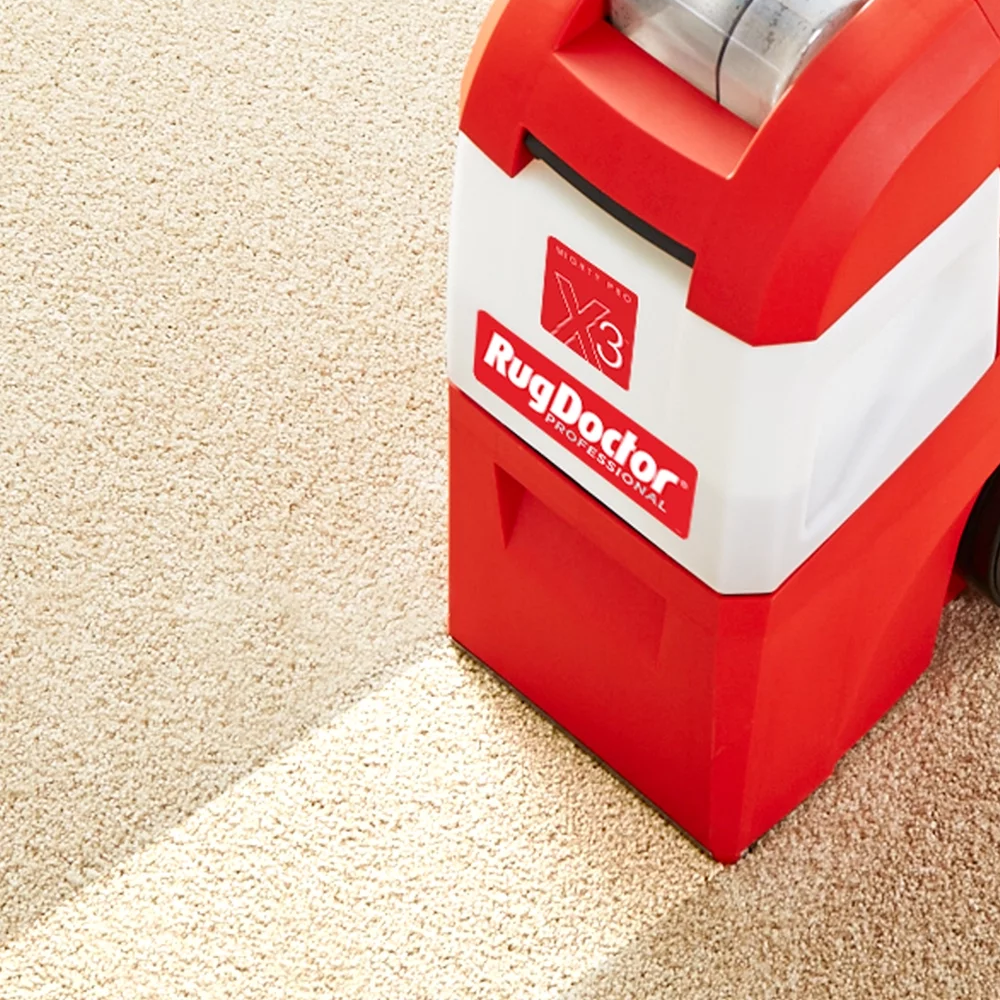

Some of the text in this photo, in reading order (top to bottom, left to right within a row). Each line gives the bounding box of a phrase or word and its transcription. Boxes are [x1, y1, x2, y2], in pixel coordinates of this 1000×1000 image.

[556, 245, 632, 304] MIGHTY PRO
[544, 413, 667, 513] PROFESSIONAL
